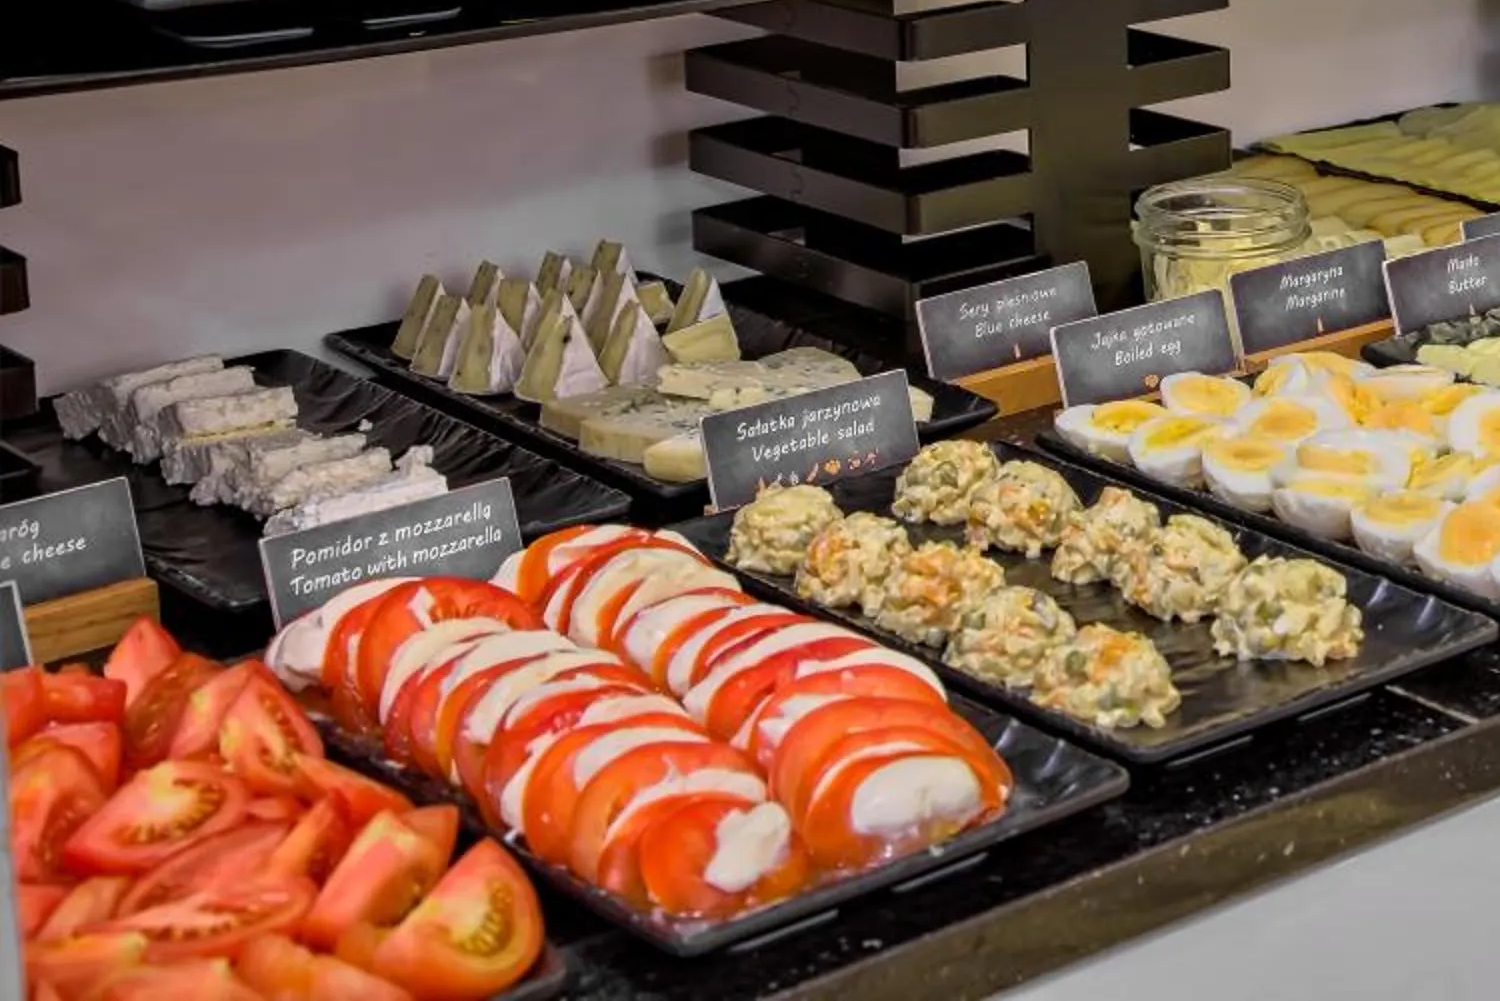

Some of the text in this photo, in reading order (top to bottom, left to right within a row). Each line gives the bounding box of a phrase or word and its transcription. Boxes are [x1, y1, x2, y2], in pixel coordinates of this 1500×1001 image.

[1279, 265, 1344, 290] Margaryna
[1285, 286, 1346, 312] Margarine
[975, 310, 1051, 339] Blue cheese
[1115, 340, 1182, 366] Boiled egg
[801, 393, 882, 429] jarzynowa
[751, 418, 876, 462] Vegetable salad
[22, 536, 88, 564] cheese
[288, 525, 502, 597] Tomato with mozzarella
[290, 535, 373, 570] Pomidor
[377, 532, 390, 547] z
